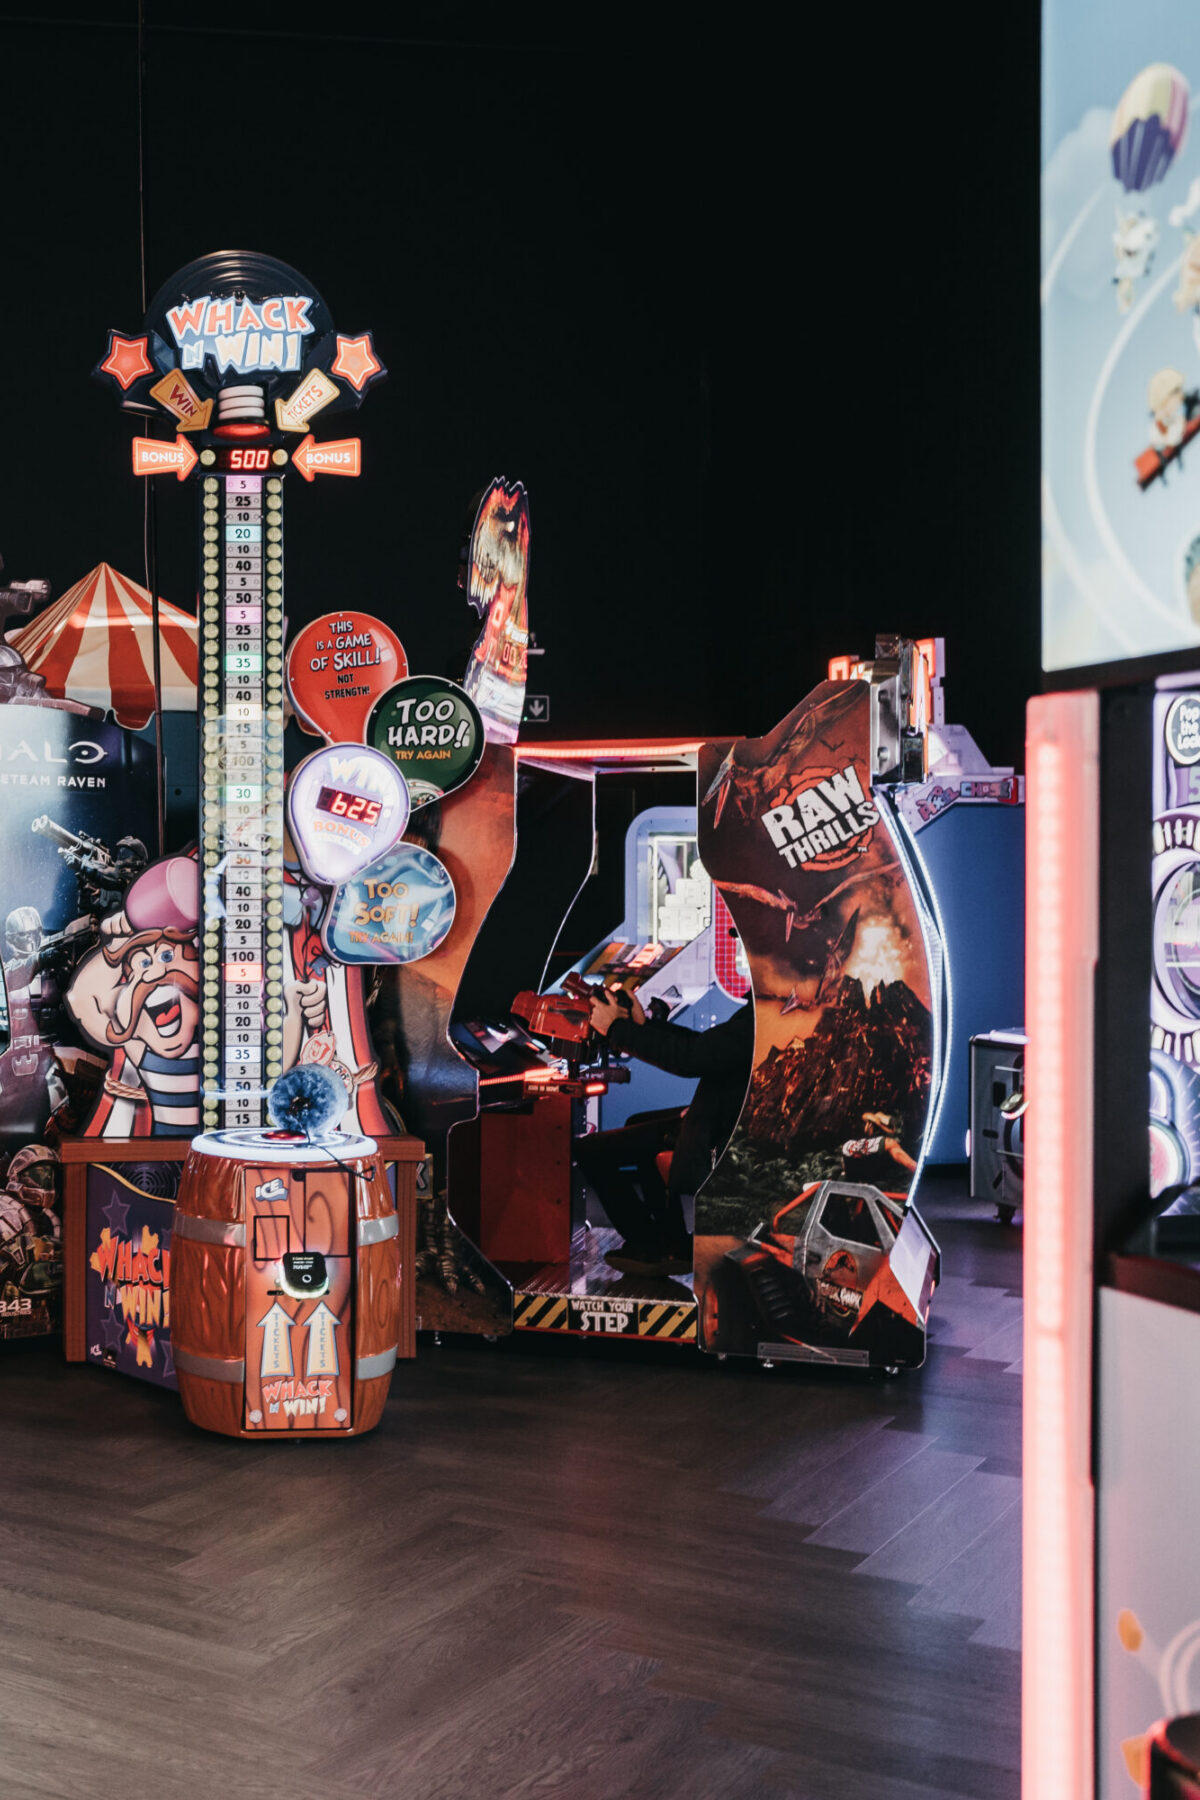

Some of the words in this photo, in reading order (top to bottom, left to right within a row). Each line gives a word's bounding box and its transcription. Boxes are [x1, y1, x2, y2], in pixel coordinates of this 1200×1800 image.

[167, 296, 314, 336] WHACK
[182, 340, 205, 368] N
[215, 333, 300, 371] WIN!
[169, 384, 199, 418] WIN
[287, 385, 324, 420] TICKETS
[141, 452, 184, 464] BONUS
[230, 450, 269, 469] 500
[306, 452, 351, 464] BONUS
[240, 480, 246, 489] 5
[235, 496, 251, 507] 25
[238, 512, 250, 522] 10
[235, 529, 250, 539] 20
[238, 545, 250, 554] 10
[235, 561, 251, 572] 40
[240, 578, 247, 586] 5
[236, 593, 252, 604] 50
[240, 610, 246, 619] 5
[235, 625, 252, 636] 25
[329, 621, 353, 634] THIS
[238, 643, 250, 652] 10
[316, 642, 325, 650] IS
[335, 634, 372, 649] GAME
[236, 658, 250, 668] 35
[310, 657, 329, 672] OF
[333, 648, 381, 671] SKILL!
[238, 676, 250, 684] 10
[337, 674, 354, 684] NOT
[236, 690, 252, 701] 40
[324, 686, 370, 700] STRENGTH!
[238, 708, 250, 716] 10
[396, 698, 455, 725] TOO
[387, 719, 470, 749] HARD!
[395, 750, 414, 760] TRY
[416, 750, 451, 760] AGAIN
[57, 776, 106, 788] RAVEN
[236, 788, 250, 798] 30
[331, 793, 382, 825] 625
[761, 765, 865, 849] RAW
[313, 821, 371, 847] BONUS
[779, 801, 880, 869] THRILLS
[236, 886, 251, 897] 40
[363, 878, 409, 900] TOO
[238, 904, 250, 912] 10
[354, 903, 420, 928] SOFT!
[235, 919, 251, 930] 20
[240, 936, 247, 944] 5
[350, 932, 368, 944] TRY
[232, 951, 254, 962] 100
[240, 968, 246, 977] 5
[235, 984, 251, 994] 30
[237, 1001, 249, 1010] 10
[235, 1017, 251, 1027] 20
[237, 1034, 249, 1042] 10
[235, 1049, 250, 1060] 35
[240, 1066, 246, 1075] 5
[235, 1082, 251, 1092] 50
[237, 1098, 249, 1108] 10
[235, 1114, 250, 1124] 15
[255, 1178, 288, 1200] ICE
[571, 1300, 604, 1311] WATCH
[608, 1301, 634, 1313] YOUR
[580, 1311, 629, 1332] STEP
[262, 1380, 333, 1402] WHACK
[282, 1396, 327, 1416] WIN!
